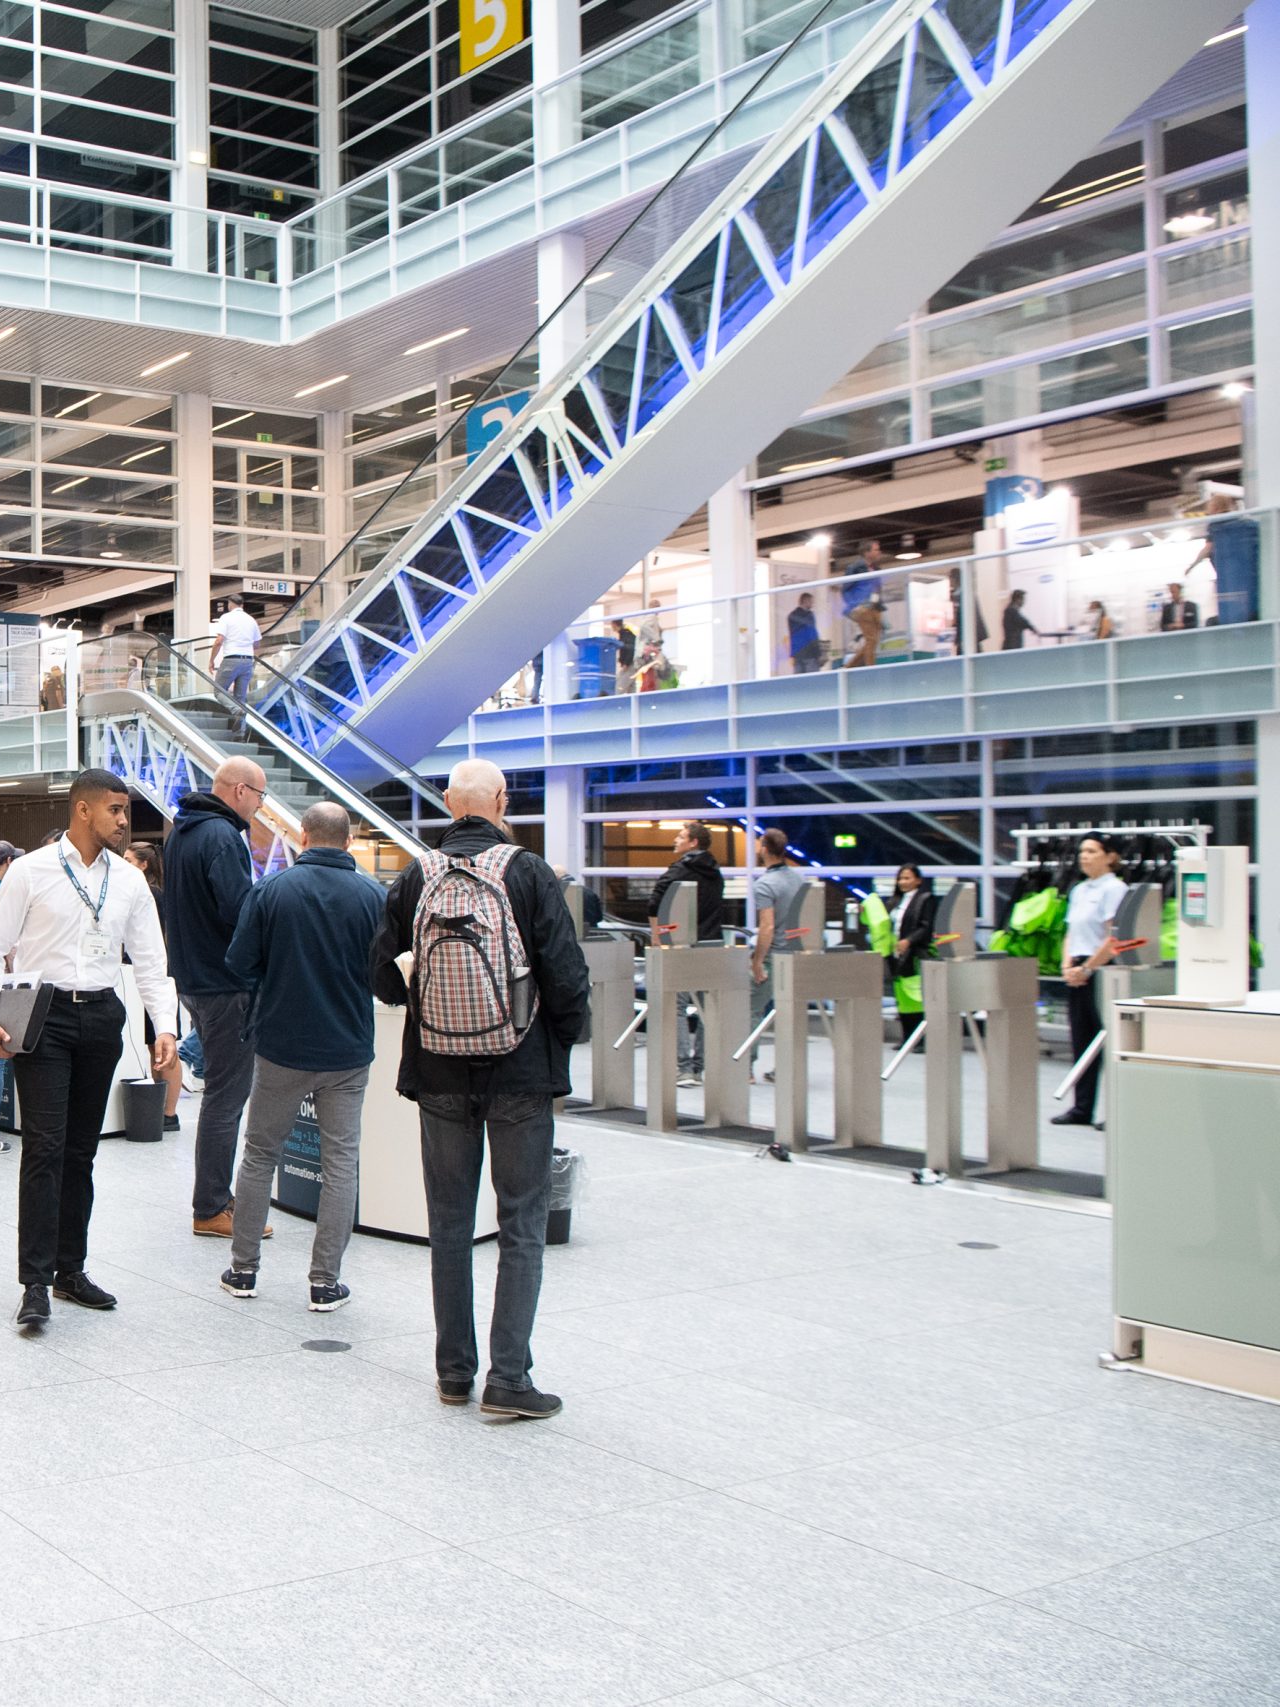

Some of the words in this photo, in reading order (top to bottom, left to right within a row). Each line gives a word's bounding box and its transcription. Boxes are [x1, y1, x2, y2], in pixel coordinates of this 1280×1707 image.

[474, 0, 508, 58] 5
[251, 581, 275, 592] Halle
[279, 583, 287, 592] 3
